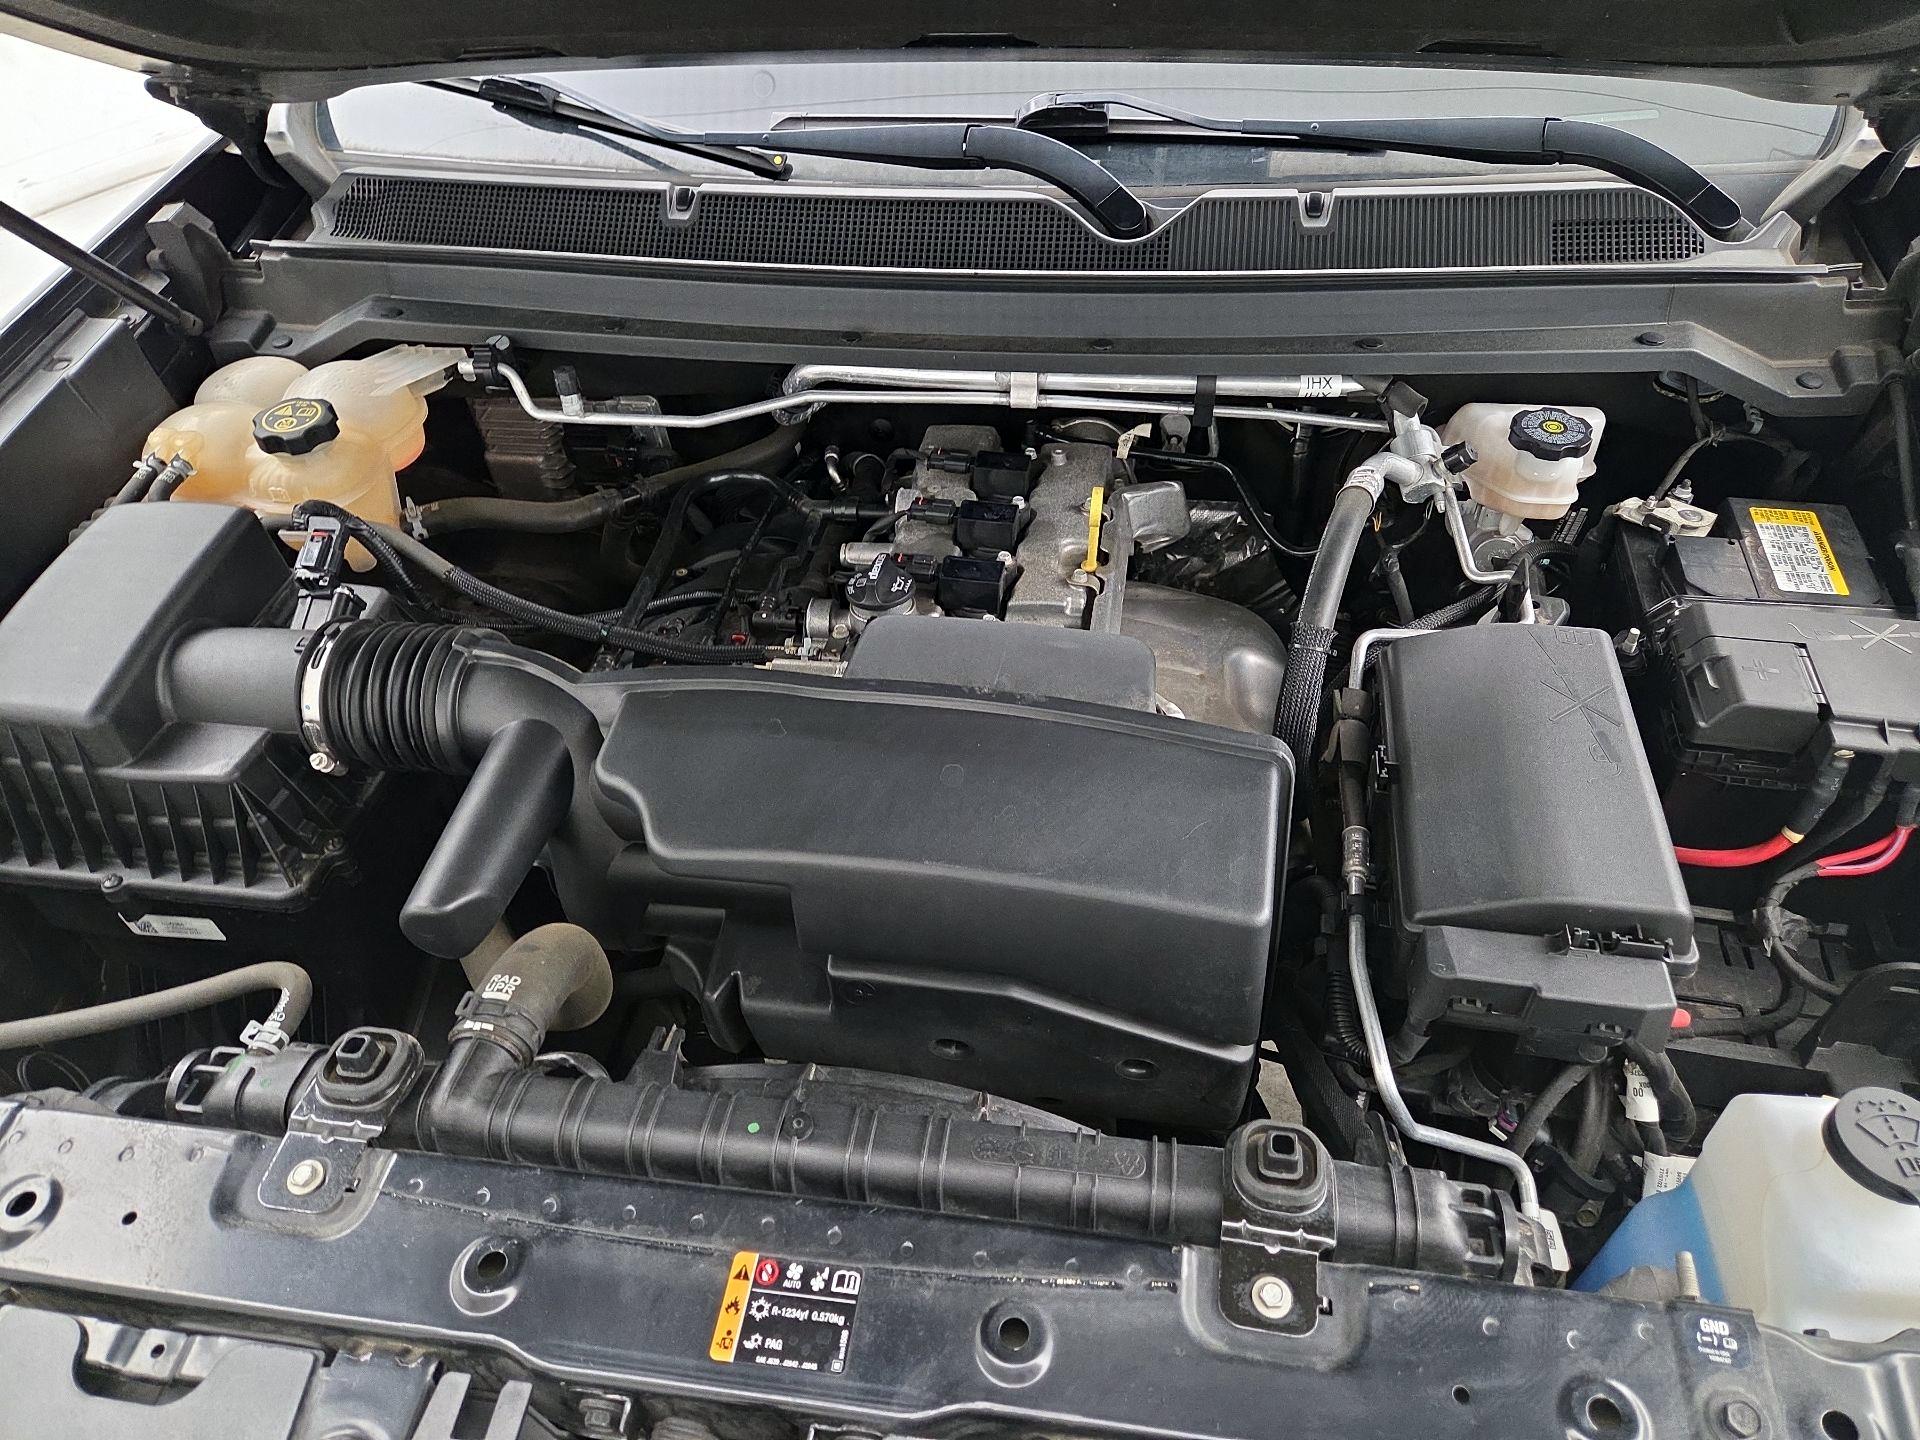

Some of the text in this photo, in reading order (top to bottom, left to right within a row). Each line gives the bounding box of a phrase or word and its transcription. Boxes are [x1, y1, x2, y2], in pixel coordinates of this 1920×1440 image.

[490, 974, 522, 986] RAD
[485, 980, 516, 996] UPR
[782, 1279, 802, 1289] AUTO
[1699, 1317, 1730, 1336] GND
[764, 1337, 783, 1351] PAG
